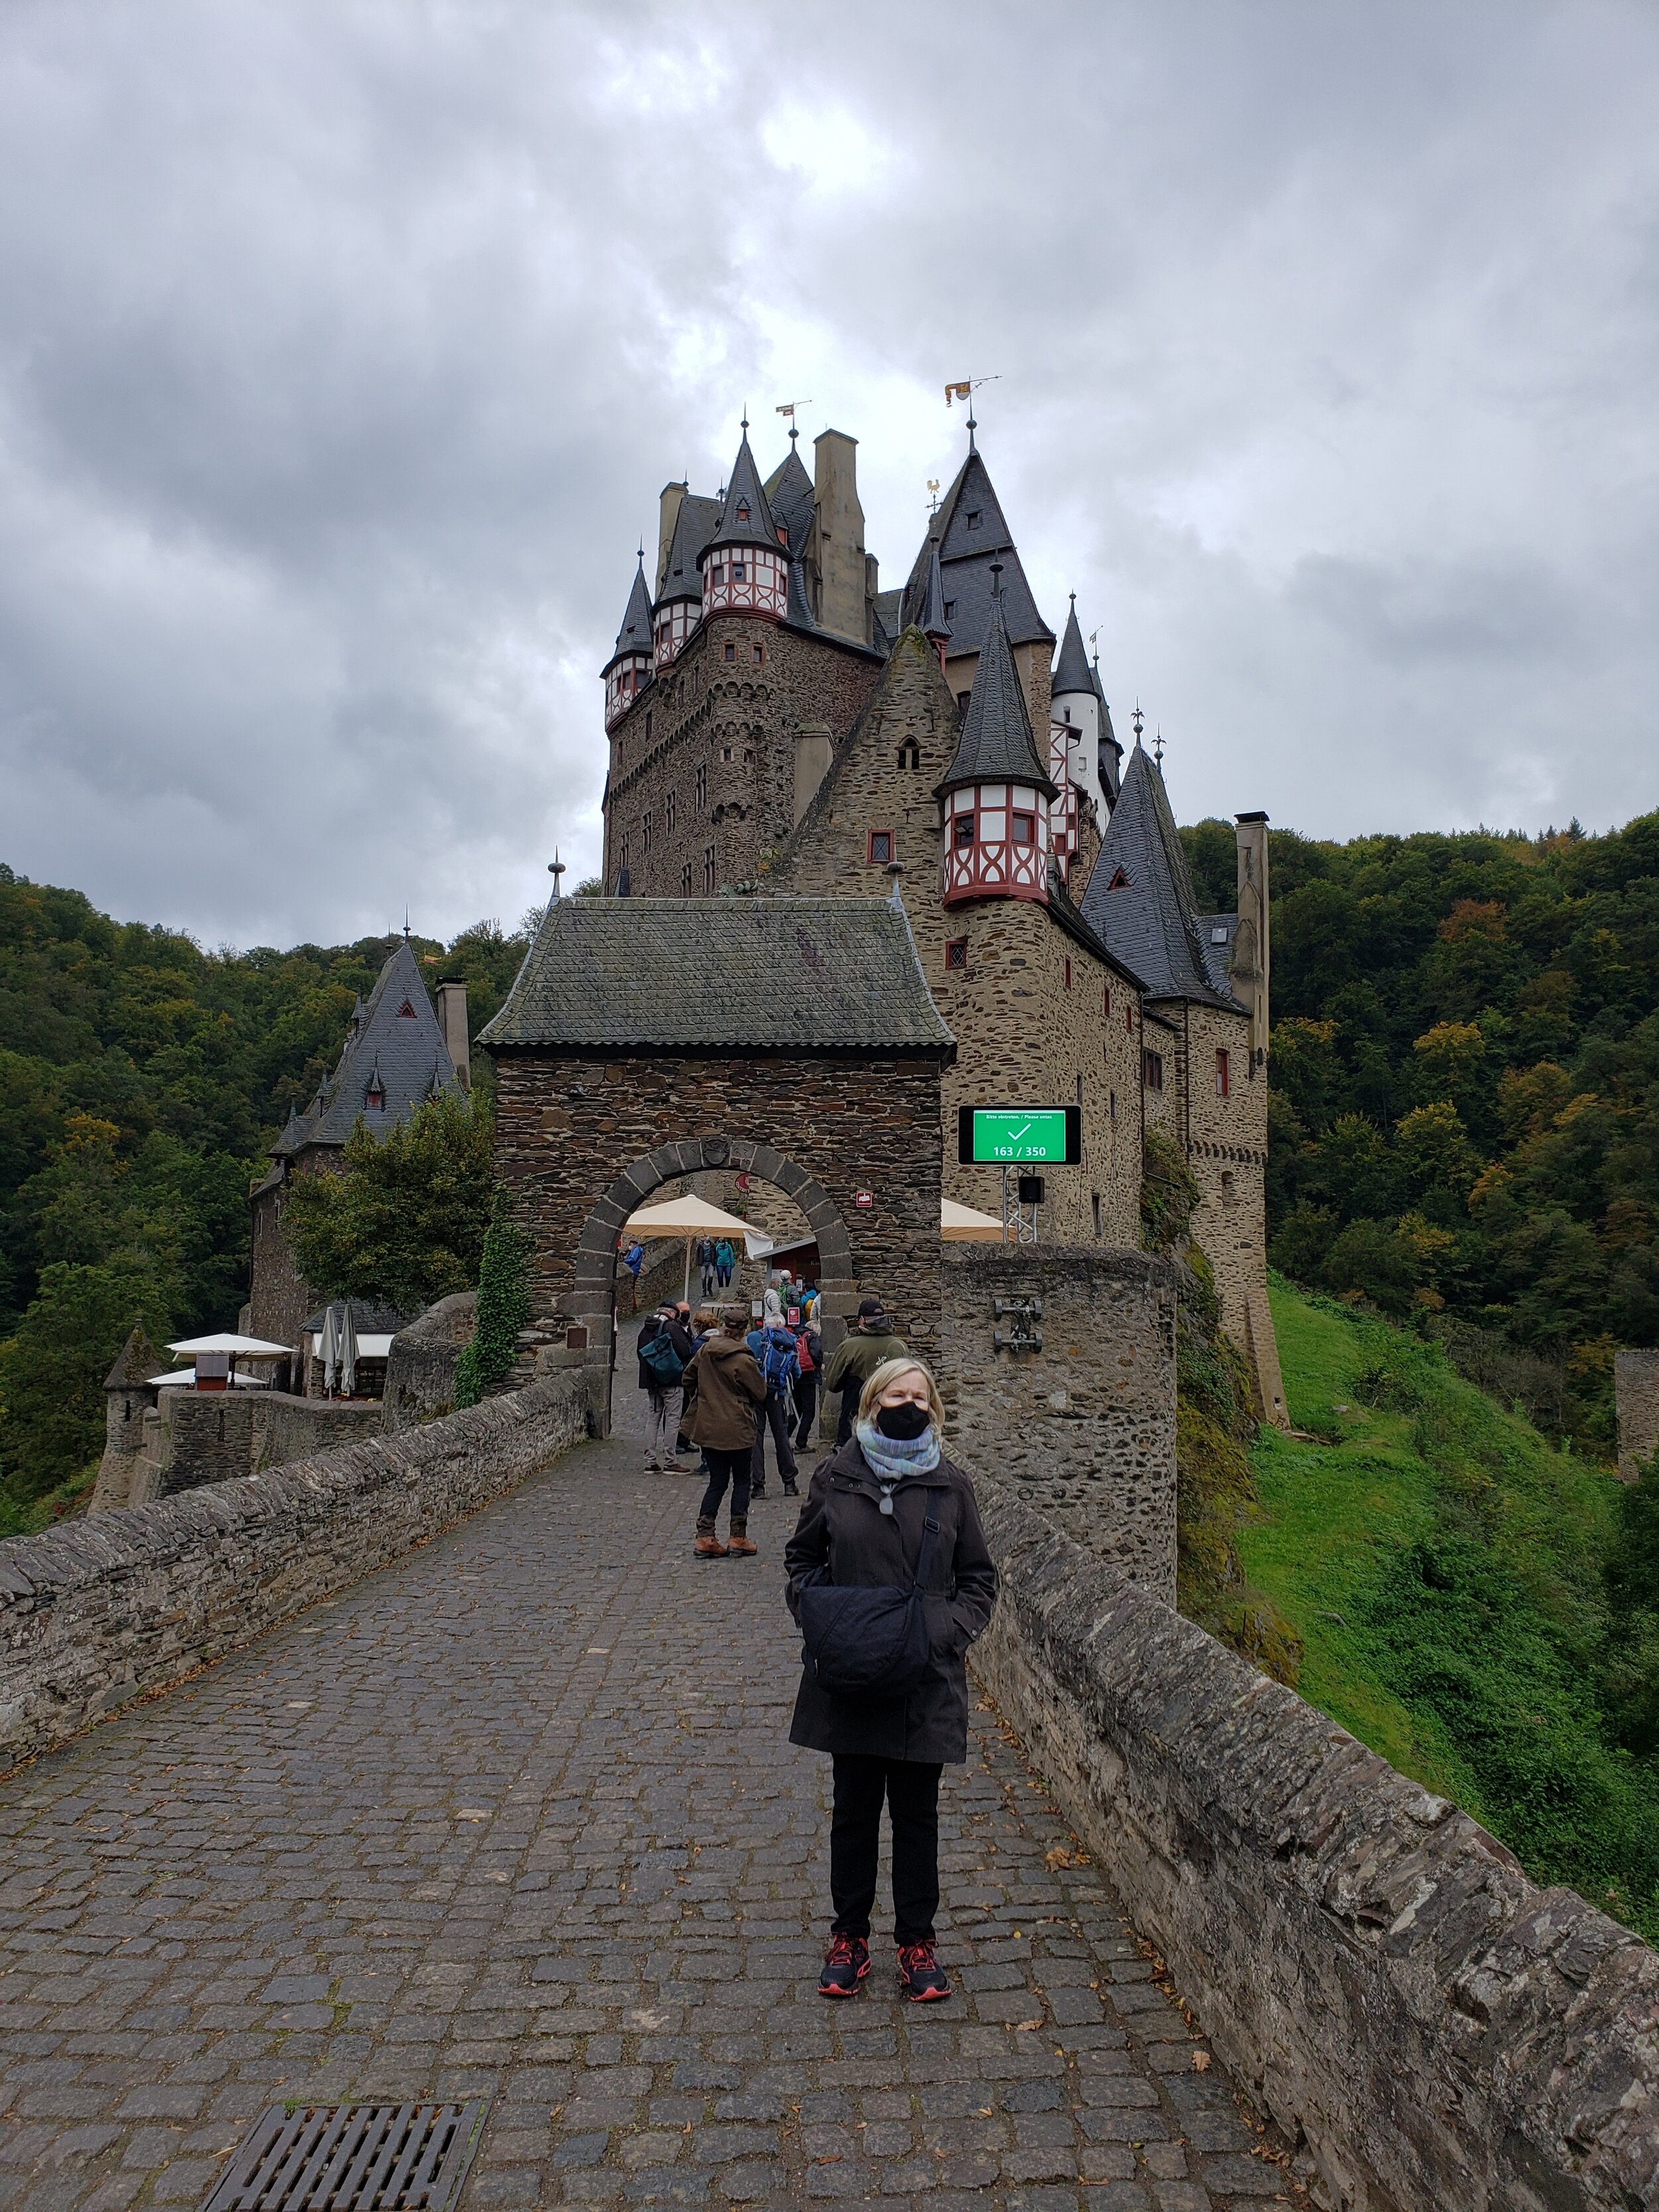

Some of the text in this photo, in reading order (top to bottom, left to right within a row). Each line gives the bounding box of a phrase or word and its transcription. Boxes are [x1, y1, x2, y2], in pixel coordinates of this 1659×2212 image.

[993, 1147, 1046, 1157] 163 / 350
